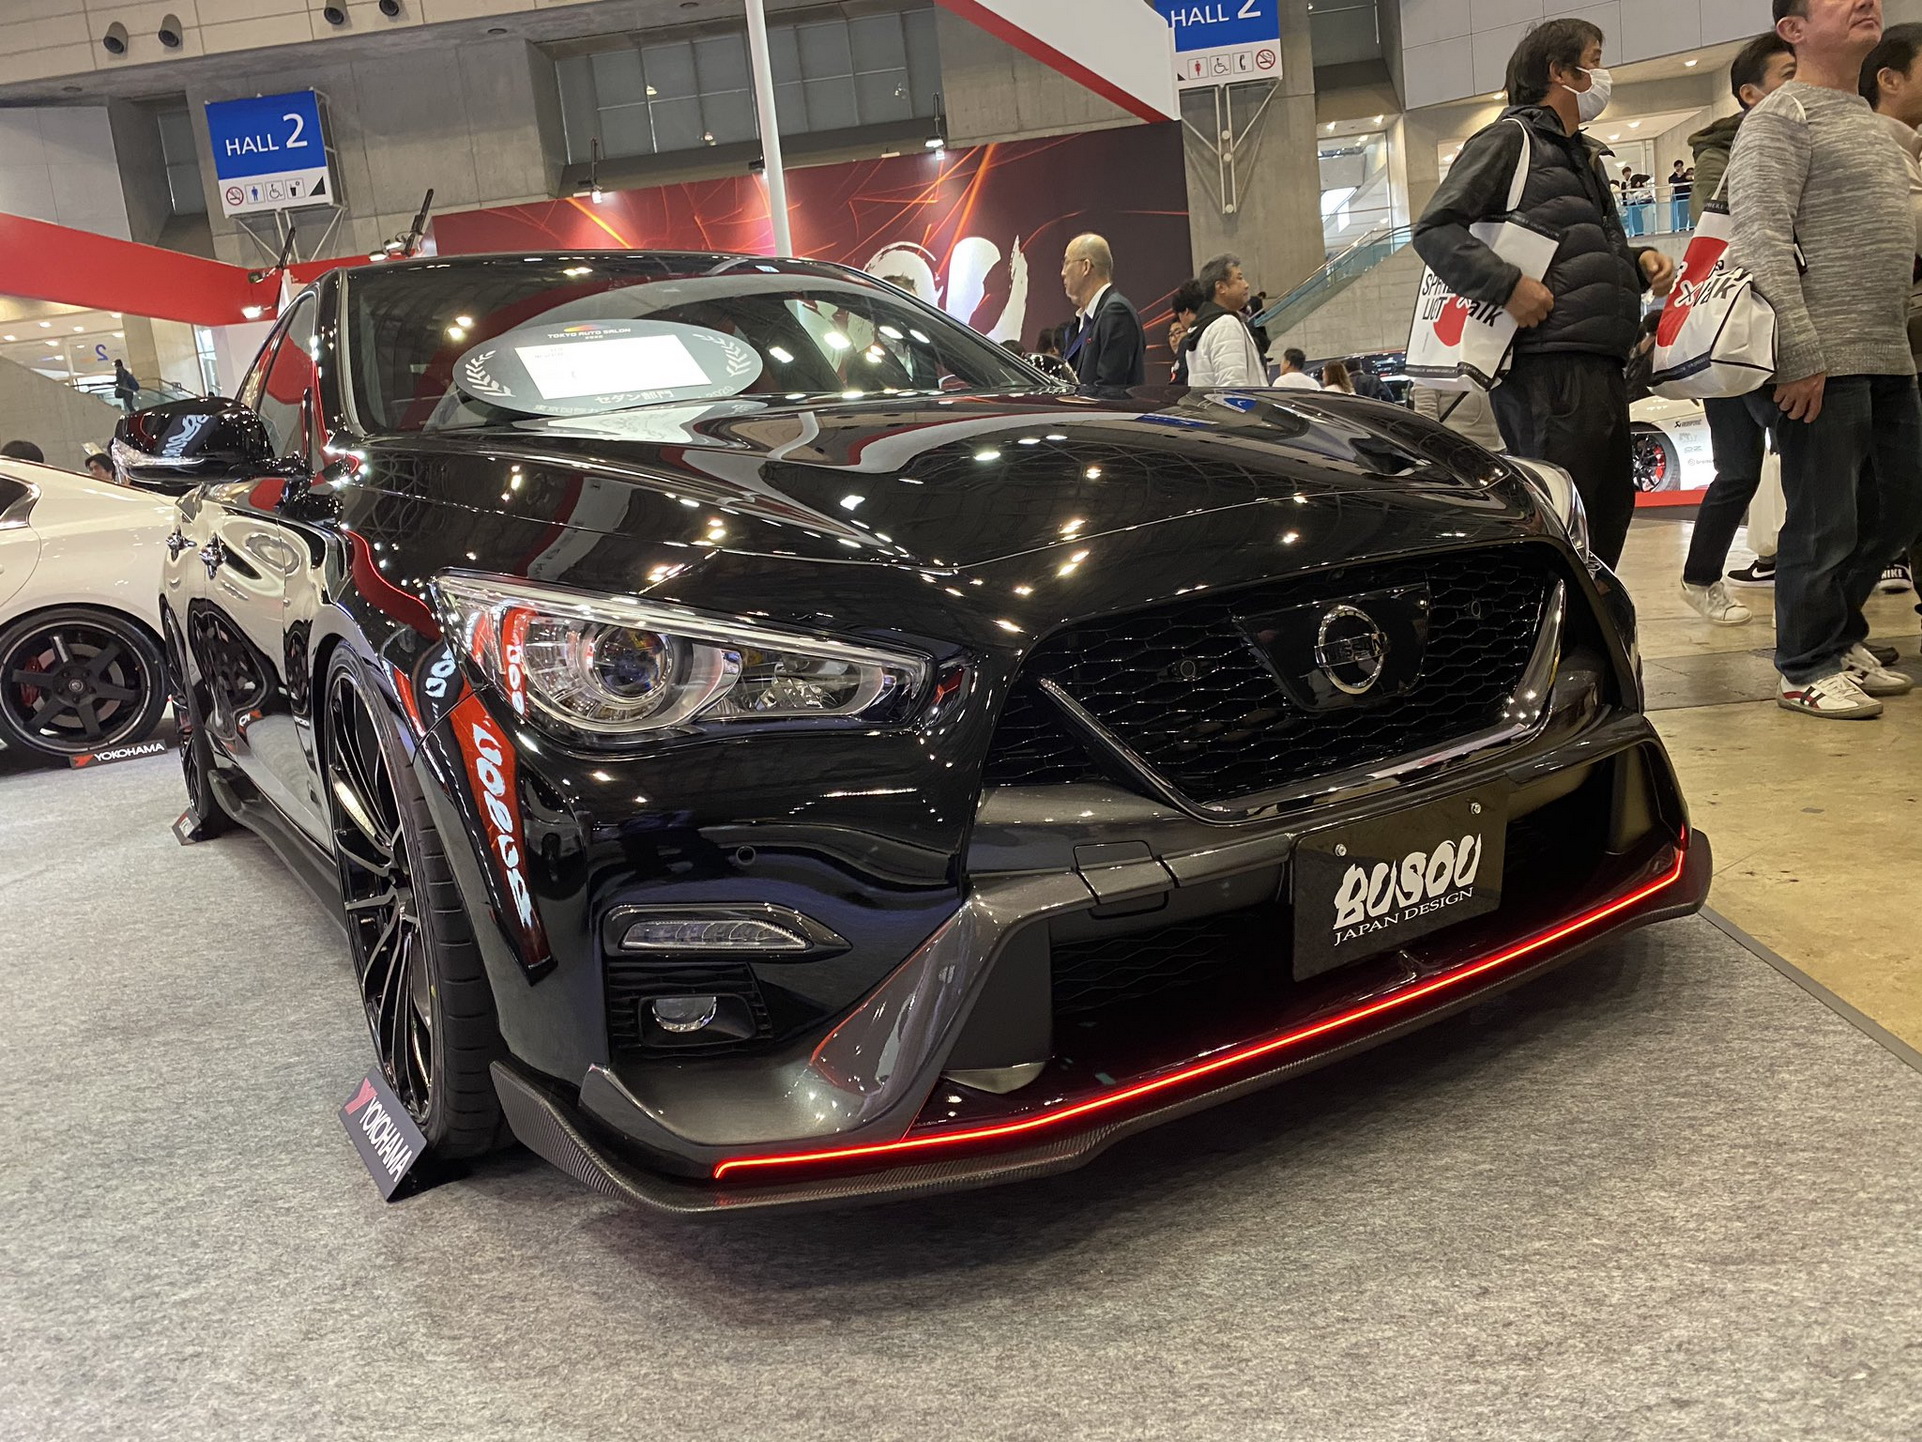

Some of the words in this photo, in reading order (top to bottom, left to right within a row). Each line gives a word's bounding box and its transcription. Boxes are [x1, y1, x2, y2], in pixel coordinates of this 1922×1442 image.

[1170, 4, 1230, 27] HALL
[225, 134, 280, 157] HALL
[282, 112, 308, 149] 2
[547, 331, 577, 339] TOKYO
[602, 327, 632, 335] SALON
[1881, 568, 1903, 580] NIKE
[94, 742, 165, 762] YOKOHAMA
[1332, 833, 1482, 930] BUSOU
[1334, 913, 1400, 946] JAPAN
[1404, 886, 1474, 921] DESIGN
[359, 1095, 413, 1183] YOKOHAMA
